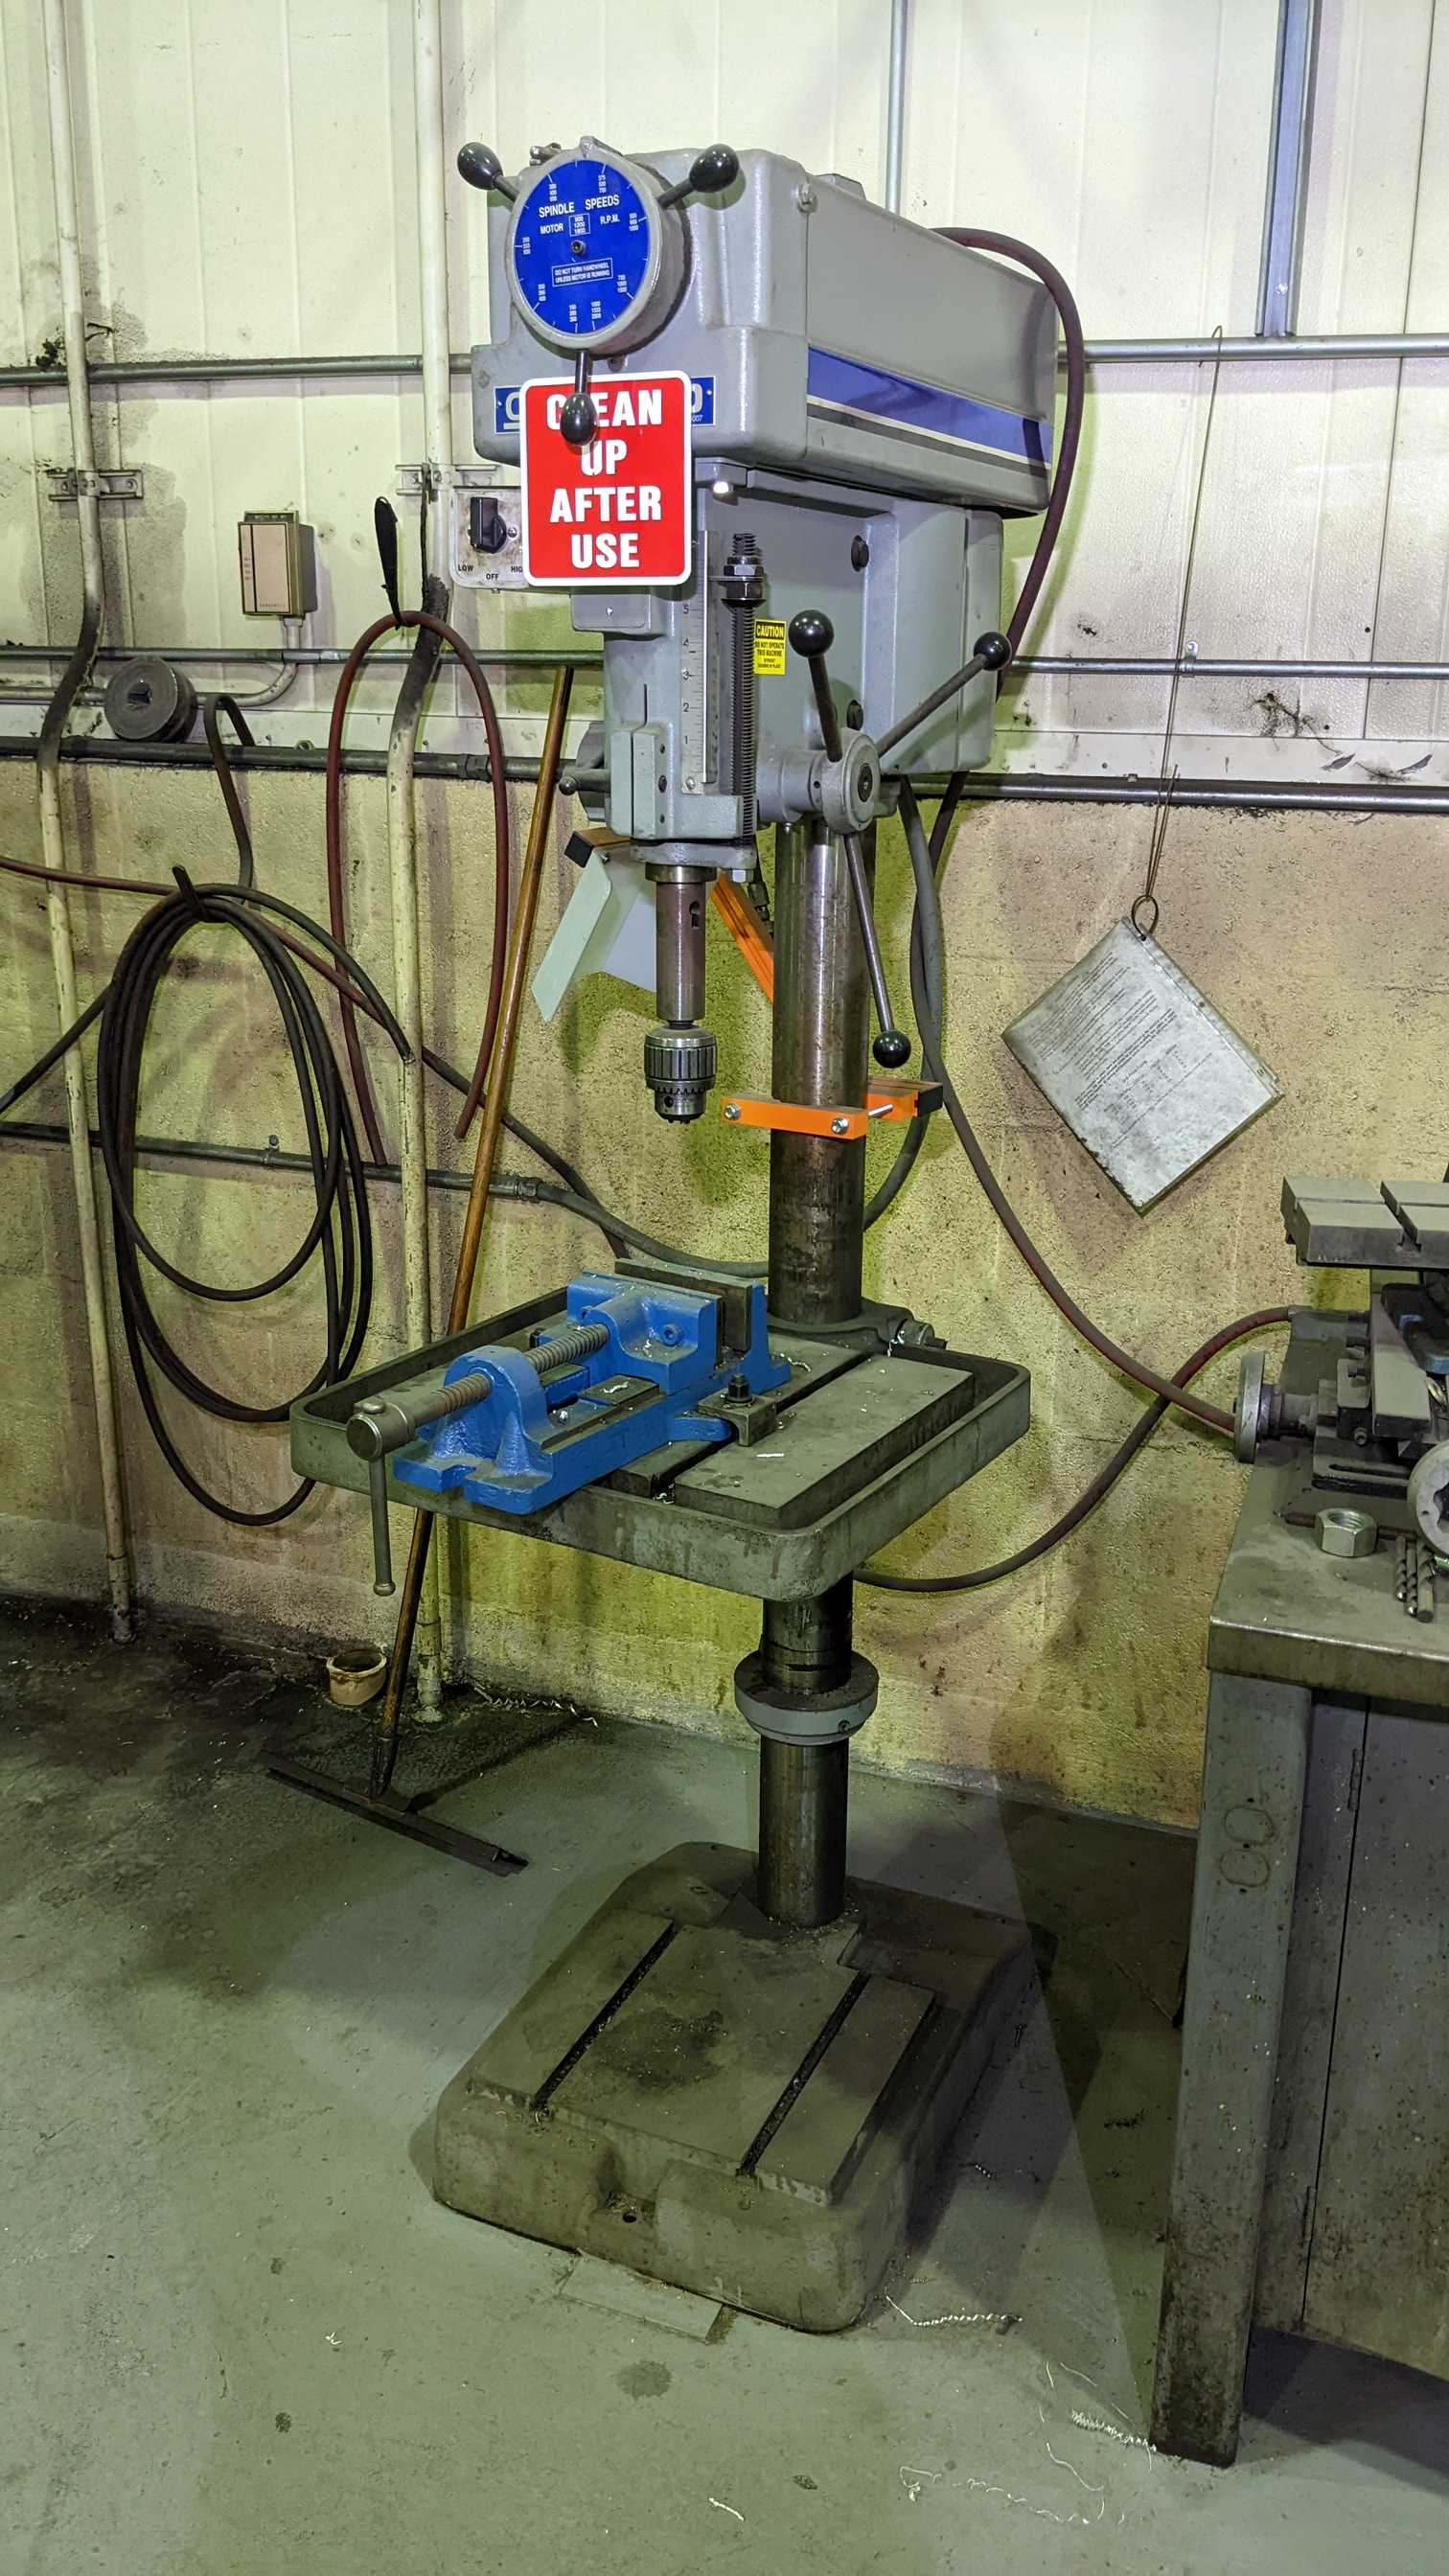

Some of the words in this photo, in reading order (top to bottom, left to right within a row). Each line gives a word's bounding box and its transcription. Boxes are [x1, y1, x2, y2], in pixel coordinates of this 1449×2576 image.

[539, 201, 575, 218] SPINDLE
[585, 194, 620, 211] SPEEDS
[540, 222, 564, 235] MOTOR
[547, 389, 662, 429] CEAN
[581, 439, 628, 476] UP
[549, 485, 662, 523] AFTER
[570, 532, 640, 569] USE
[457, 564, 474, 572] LOW
[683, 605, 689, 614] 5
[756, 624, 784, 638] CAUTION
[682, 671, 690, 680] 3
[682, 702, 689, 712] 2
